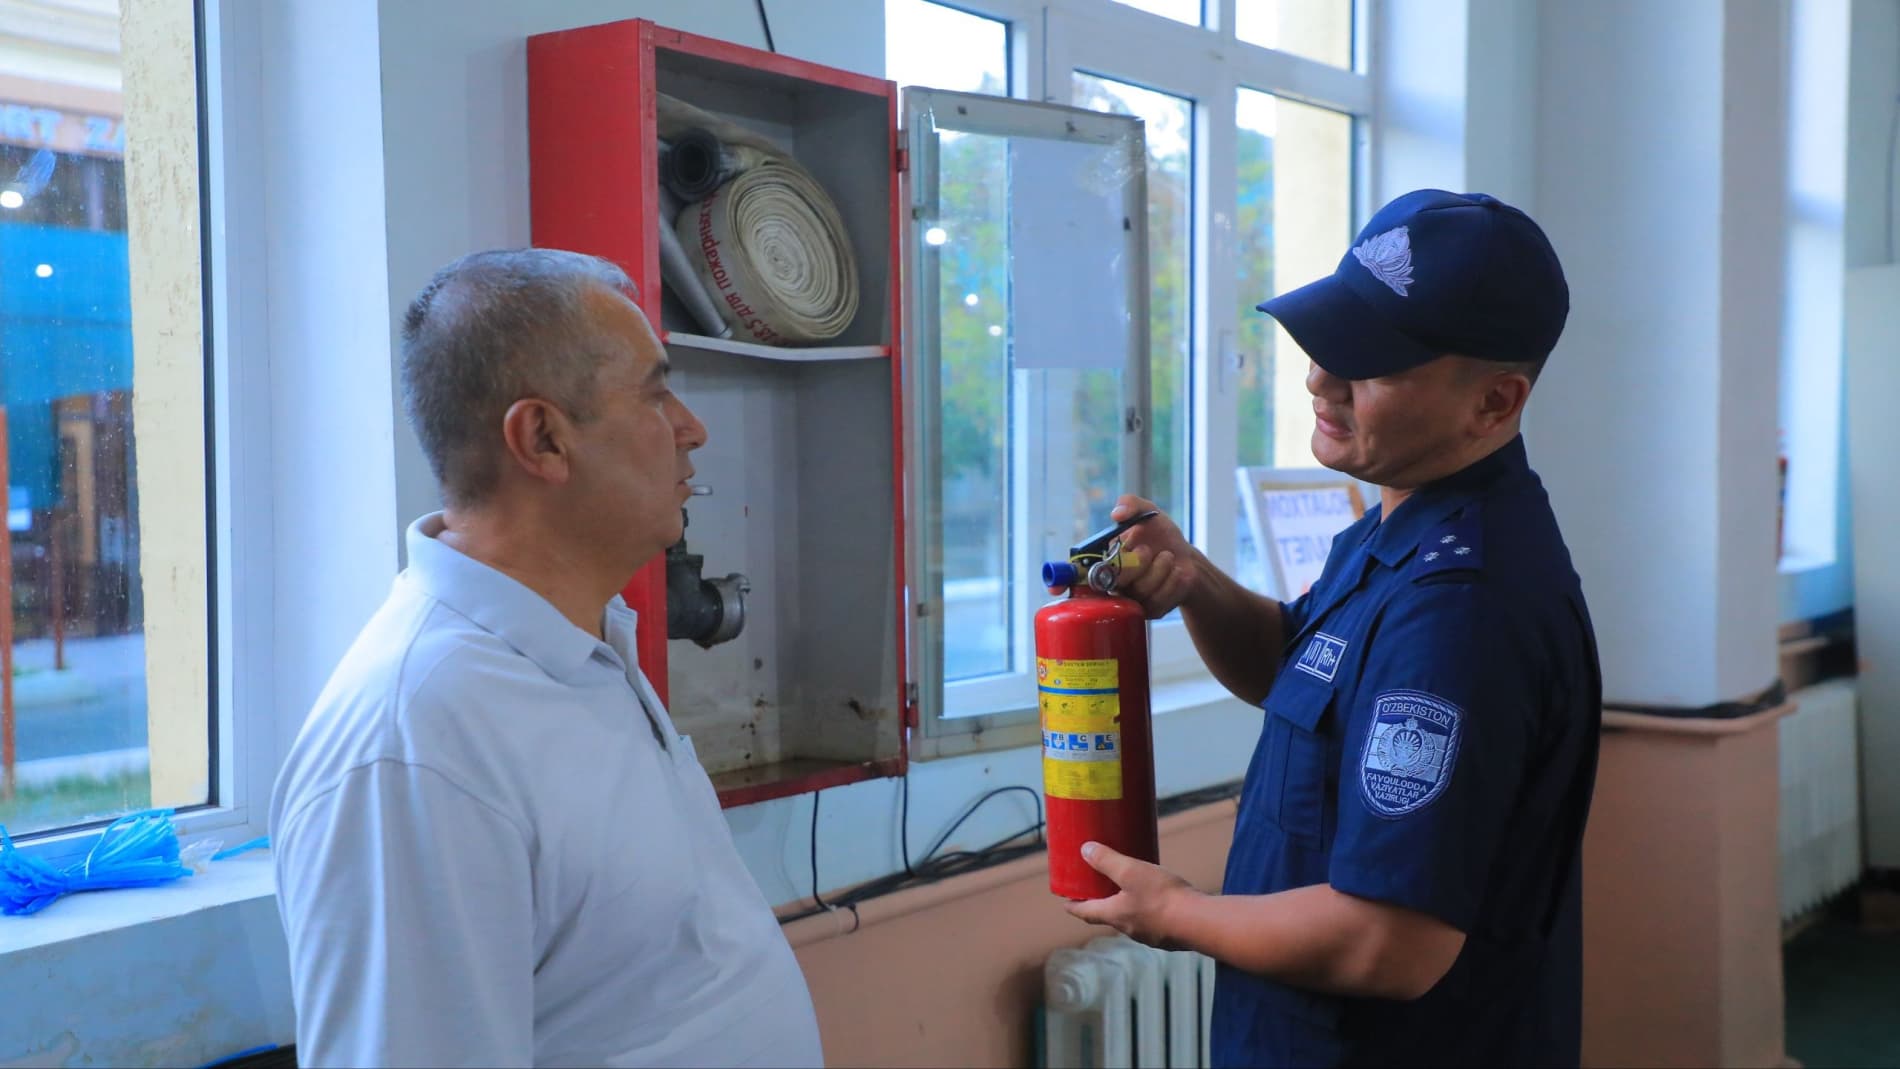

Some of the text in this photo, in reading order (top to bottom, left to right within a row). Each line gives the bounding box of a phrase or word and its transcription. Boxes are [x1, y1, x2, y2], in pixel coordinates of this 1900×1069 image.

[0, 104, 63, 144] RT
[1382, 702, 1451, 726] O'ZBEKISTON
[1105, 734, 1113, 742] E
[1371, 781, 1419, 800] VAZIYATLAR
